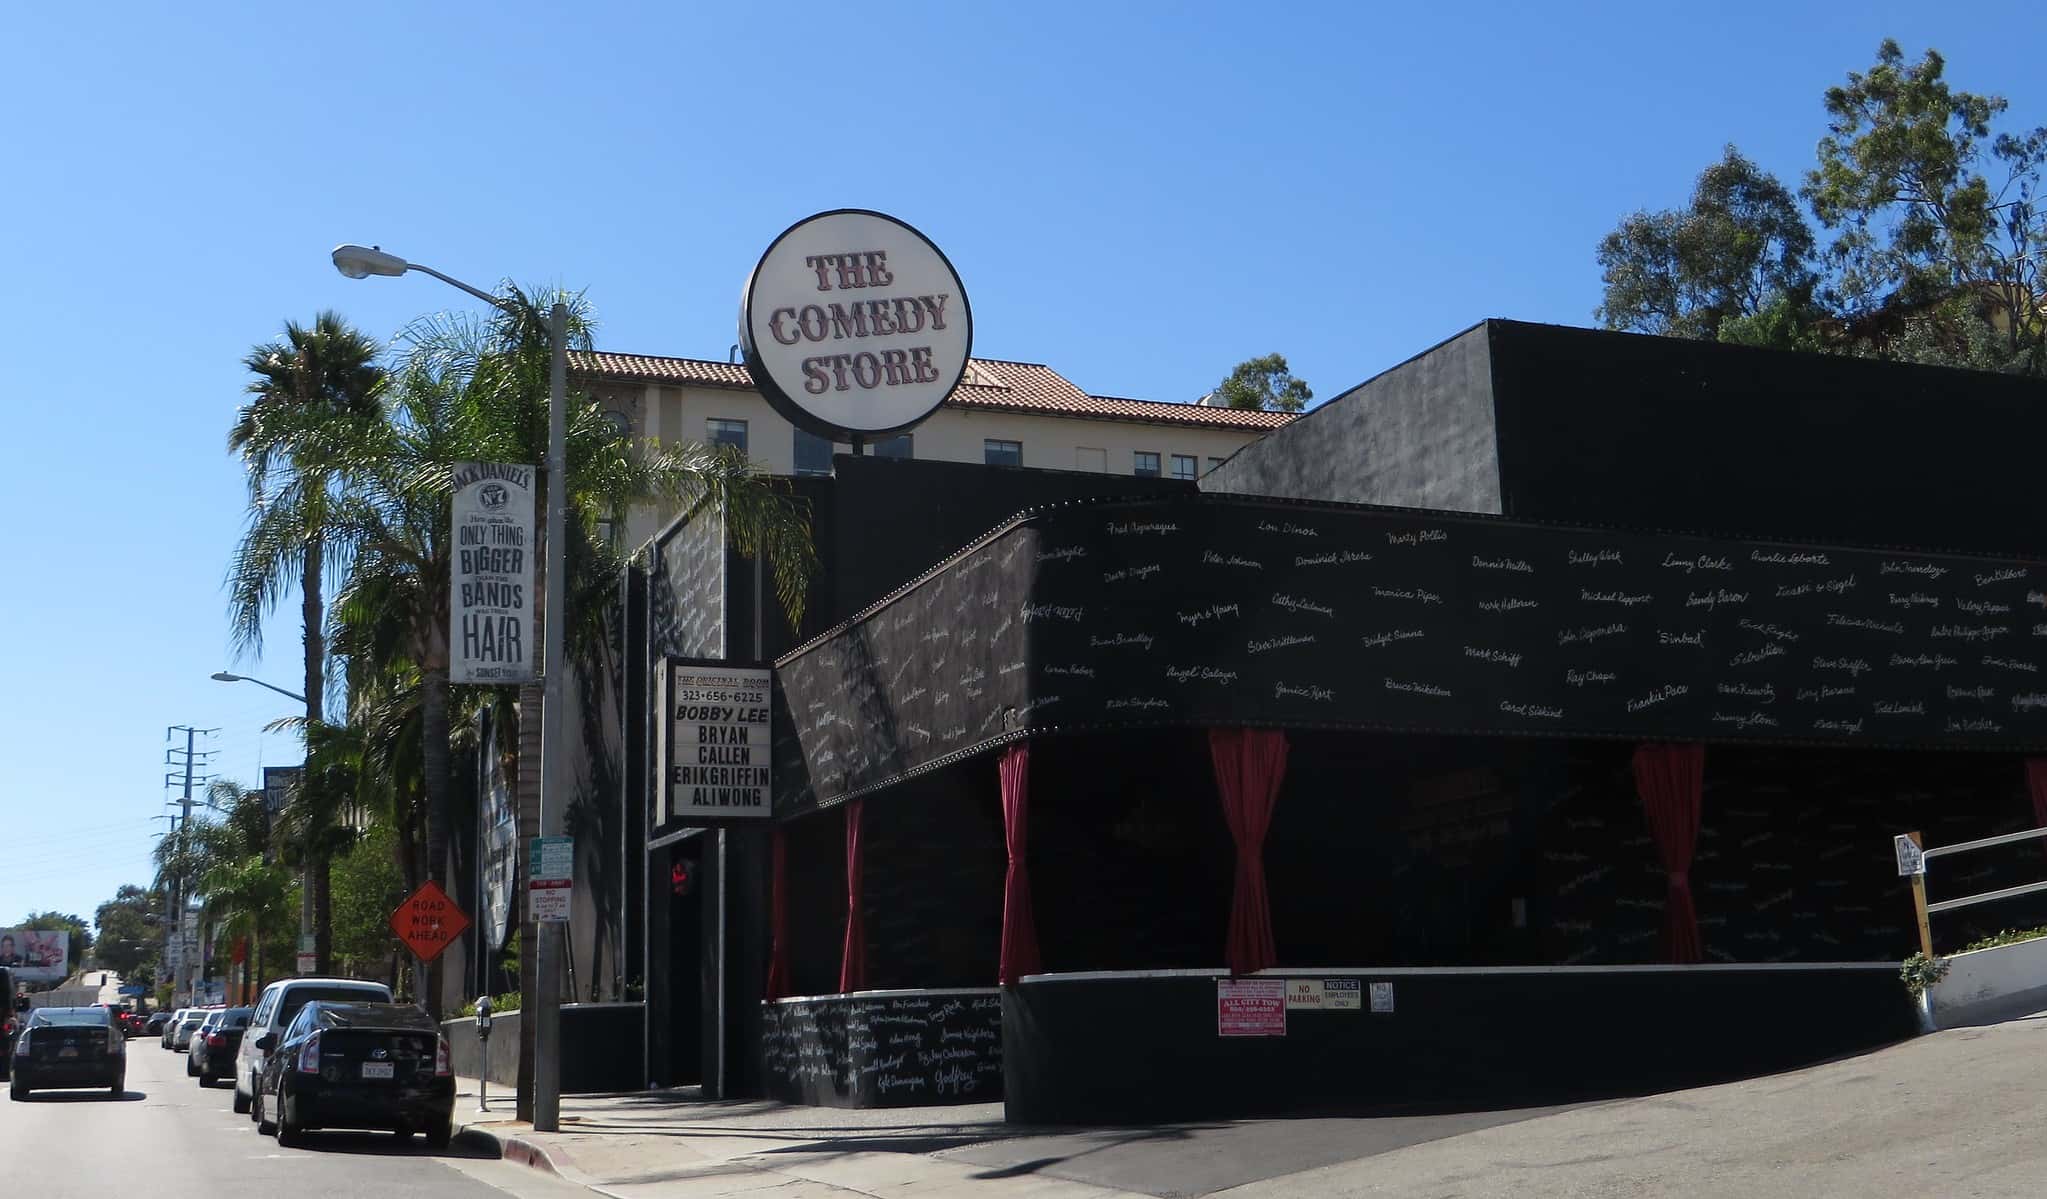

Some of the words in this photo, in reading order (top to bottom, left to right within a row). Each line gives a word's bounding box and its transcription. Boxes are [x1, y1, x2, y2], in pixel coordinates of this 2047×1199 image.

[806, 250, 894, 292] THE
[768, 293, 949, 346] COMEDY
[801, 346, 939, 394] STORE
[460, 525, 488, 546] ONLY
[490, 525, 524, 546] THING
[460, 546, 523, 575] BIGGER
[461, 582, 523, 609] BANDS
[462, 614, 522, 663] HAIR
[676, 705, 733, 721] BOBBY
[737, 708, 769, 723] LEE
[698, 725, 748, 745] BRYAN
[699, 746, 750, 765] CALLEN
[412, 900, 446, 912] ROAD
[411, 915, 445, 926] WORK
[408, 930, 448, 943] AHEAD
[1298, 984, 1310, 993] NO
[1326, 981, 1357, 990] NOTICE
[1262, 999, 1281, 1008] TOW
[1288, 995, 1321, 1004] PARKING
